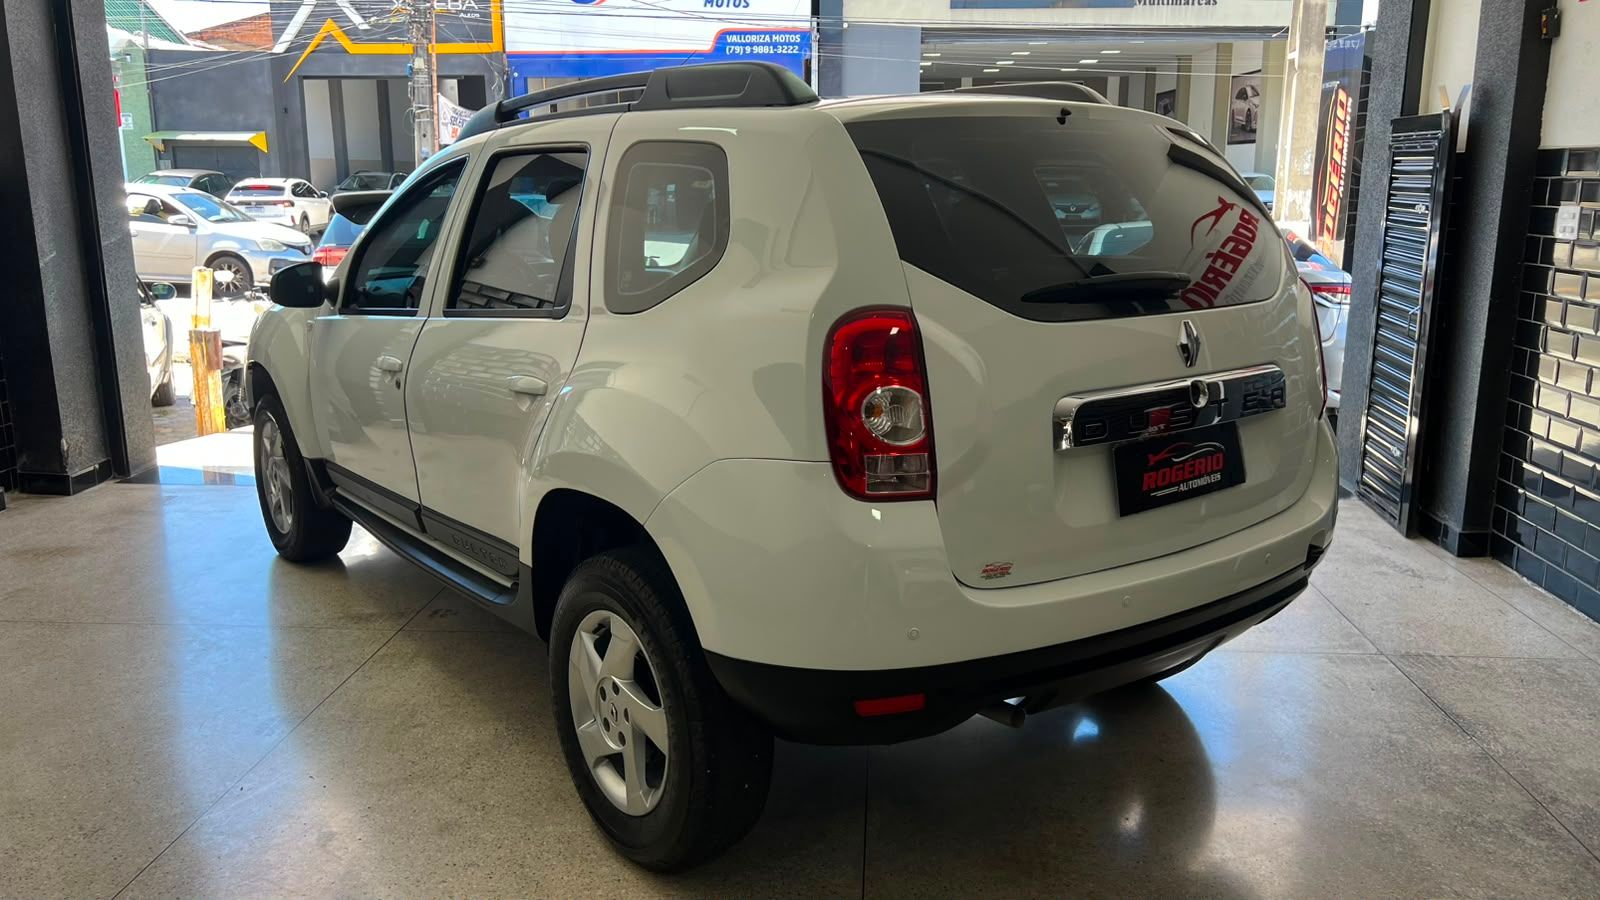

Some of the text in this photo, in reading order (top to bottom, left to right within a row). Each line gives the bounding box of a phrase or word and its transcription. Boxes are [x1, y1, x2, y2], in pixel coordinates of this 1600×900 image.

[704, 0, 750, 8] MOTOS
[726, 34, 801, 43] VALLORIZA MOTOS
[726, 45, 744, 55] (79)
[1142, 453, 1224, 490] ROGÉRIO
